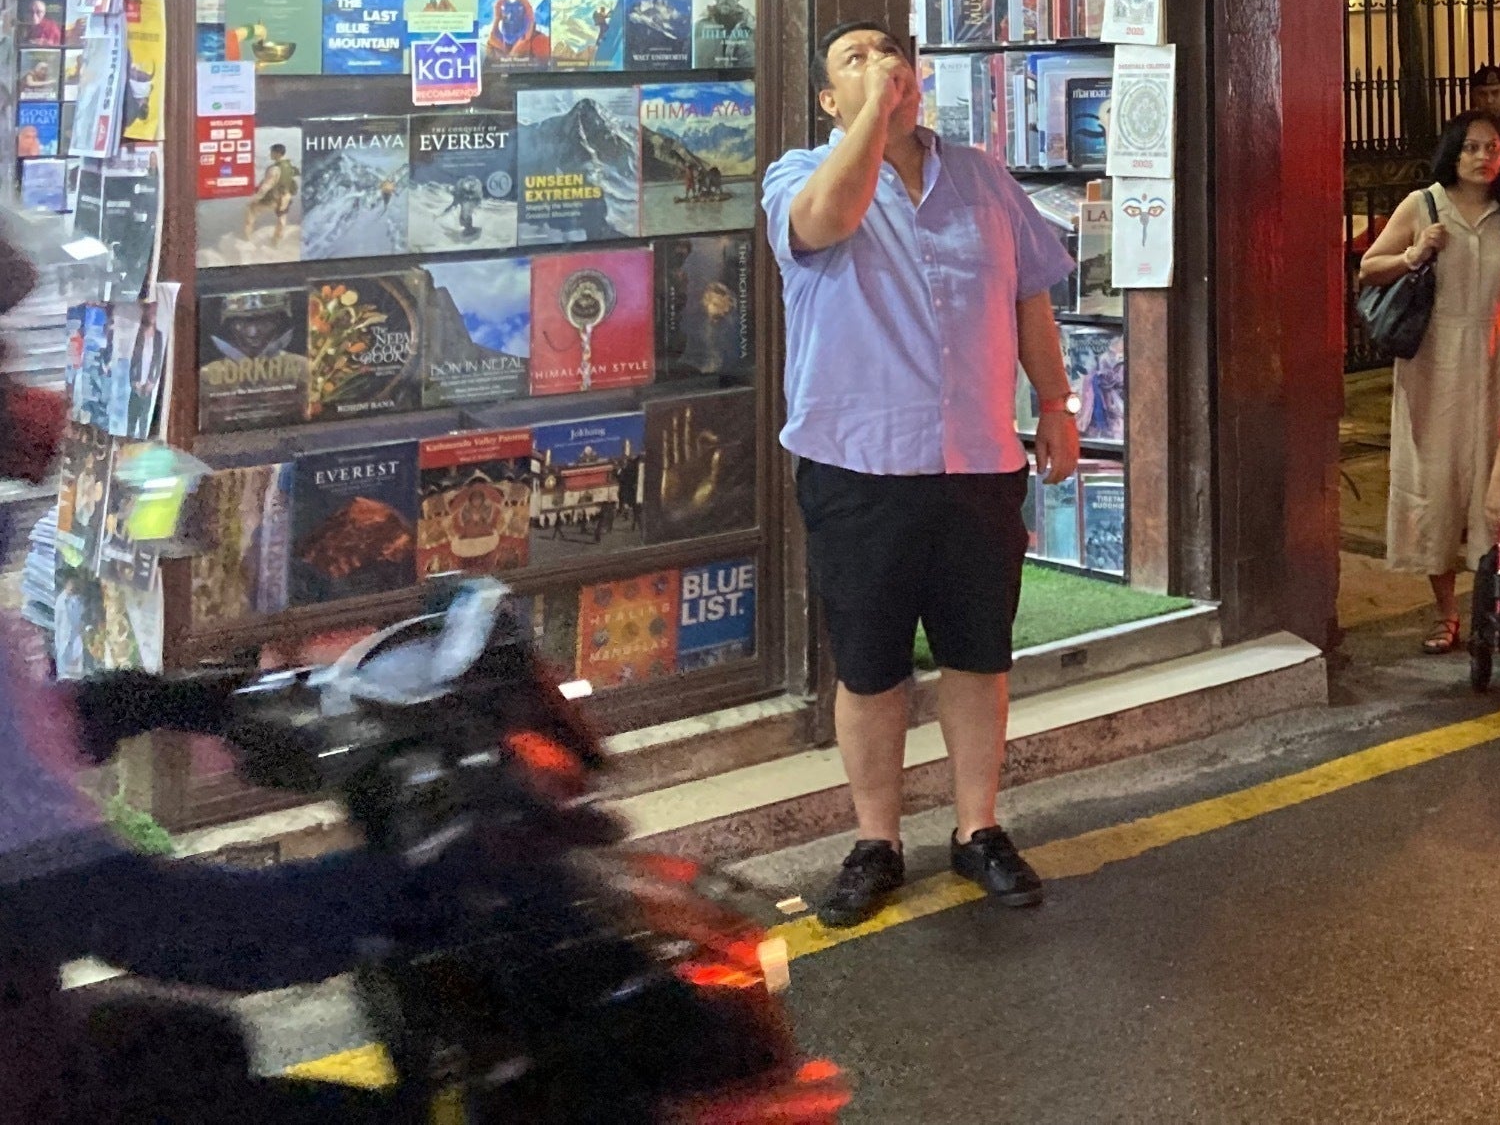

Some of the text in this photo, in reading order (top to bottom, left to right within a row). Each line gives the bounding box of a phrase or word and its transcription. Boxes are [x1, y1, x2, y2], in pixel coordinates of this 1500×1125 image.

[363, 11, 398, 22] LAST
[336, 23, 369, 34] BLUE
[329, 38, 400, 49] MOUNTAIN
[418, 57, 476, 81] KGH
[646, 101, 752, 120] HIMALAYAS
[305, 134, 405, 151] HIMALAYA
[420, 132, 510, 152] EVEREST
[525, 174, 583, 189] UNSEEN
[525, 186, 602, 203] EXTREMES
[207, 355, 299, 385] GORKHA
[612, 361, 649, 373] STYLE
[315, 460, 400, 486] EVEREST
[683, 564, 753, 600] BLUE
[681, 592, 745, 626] LIST.
